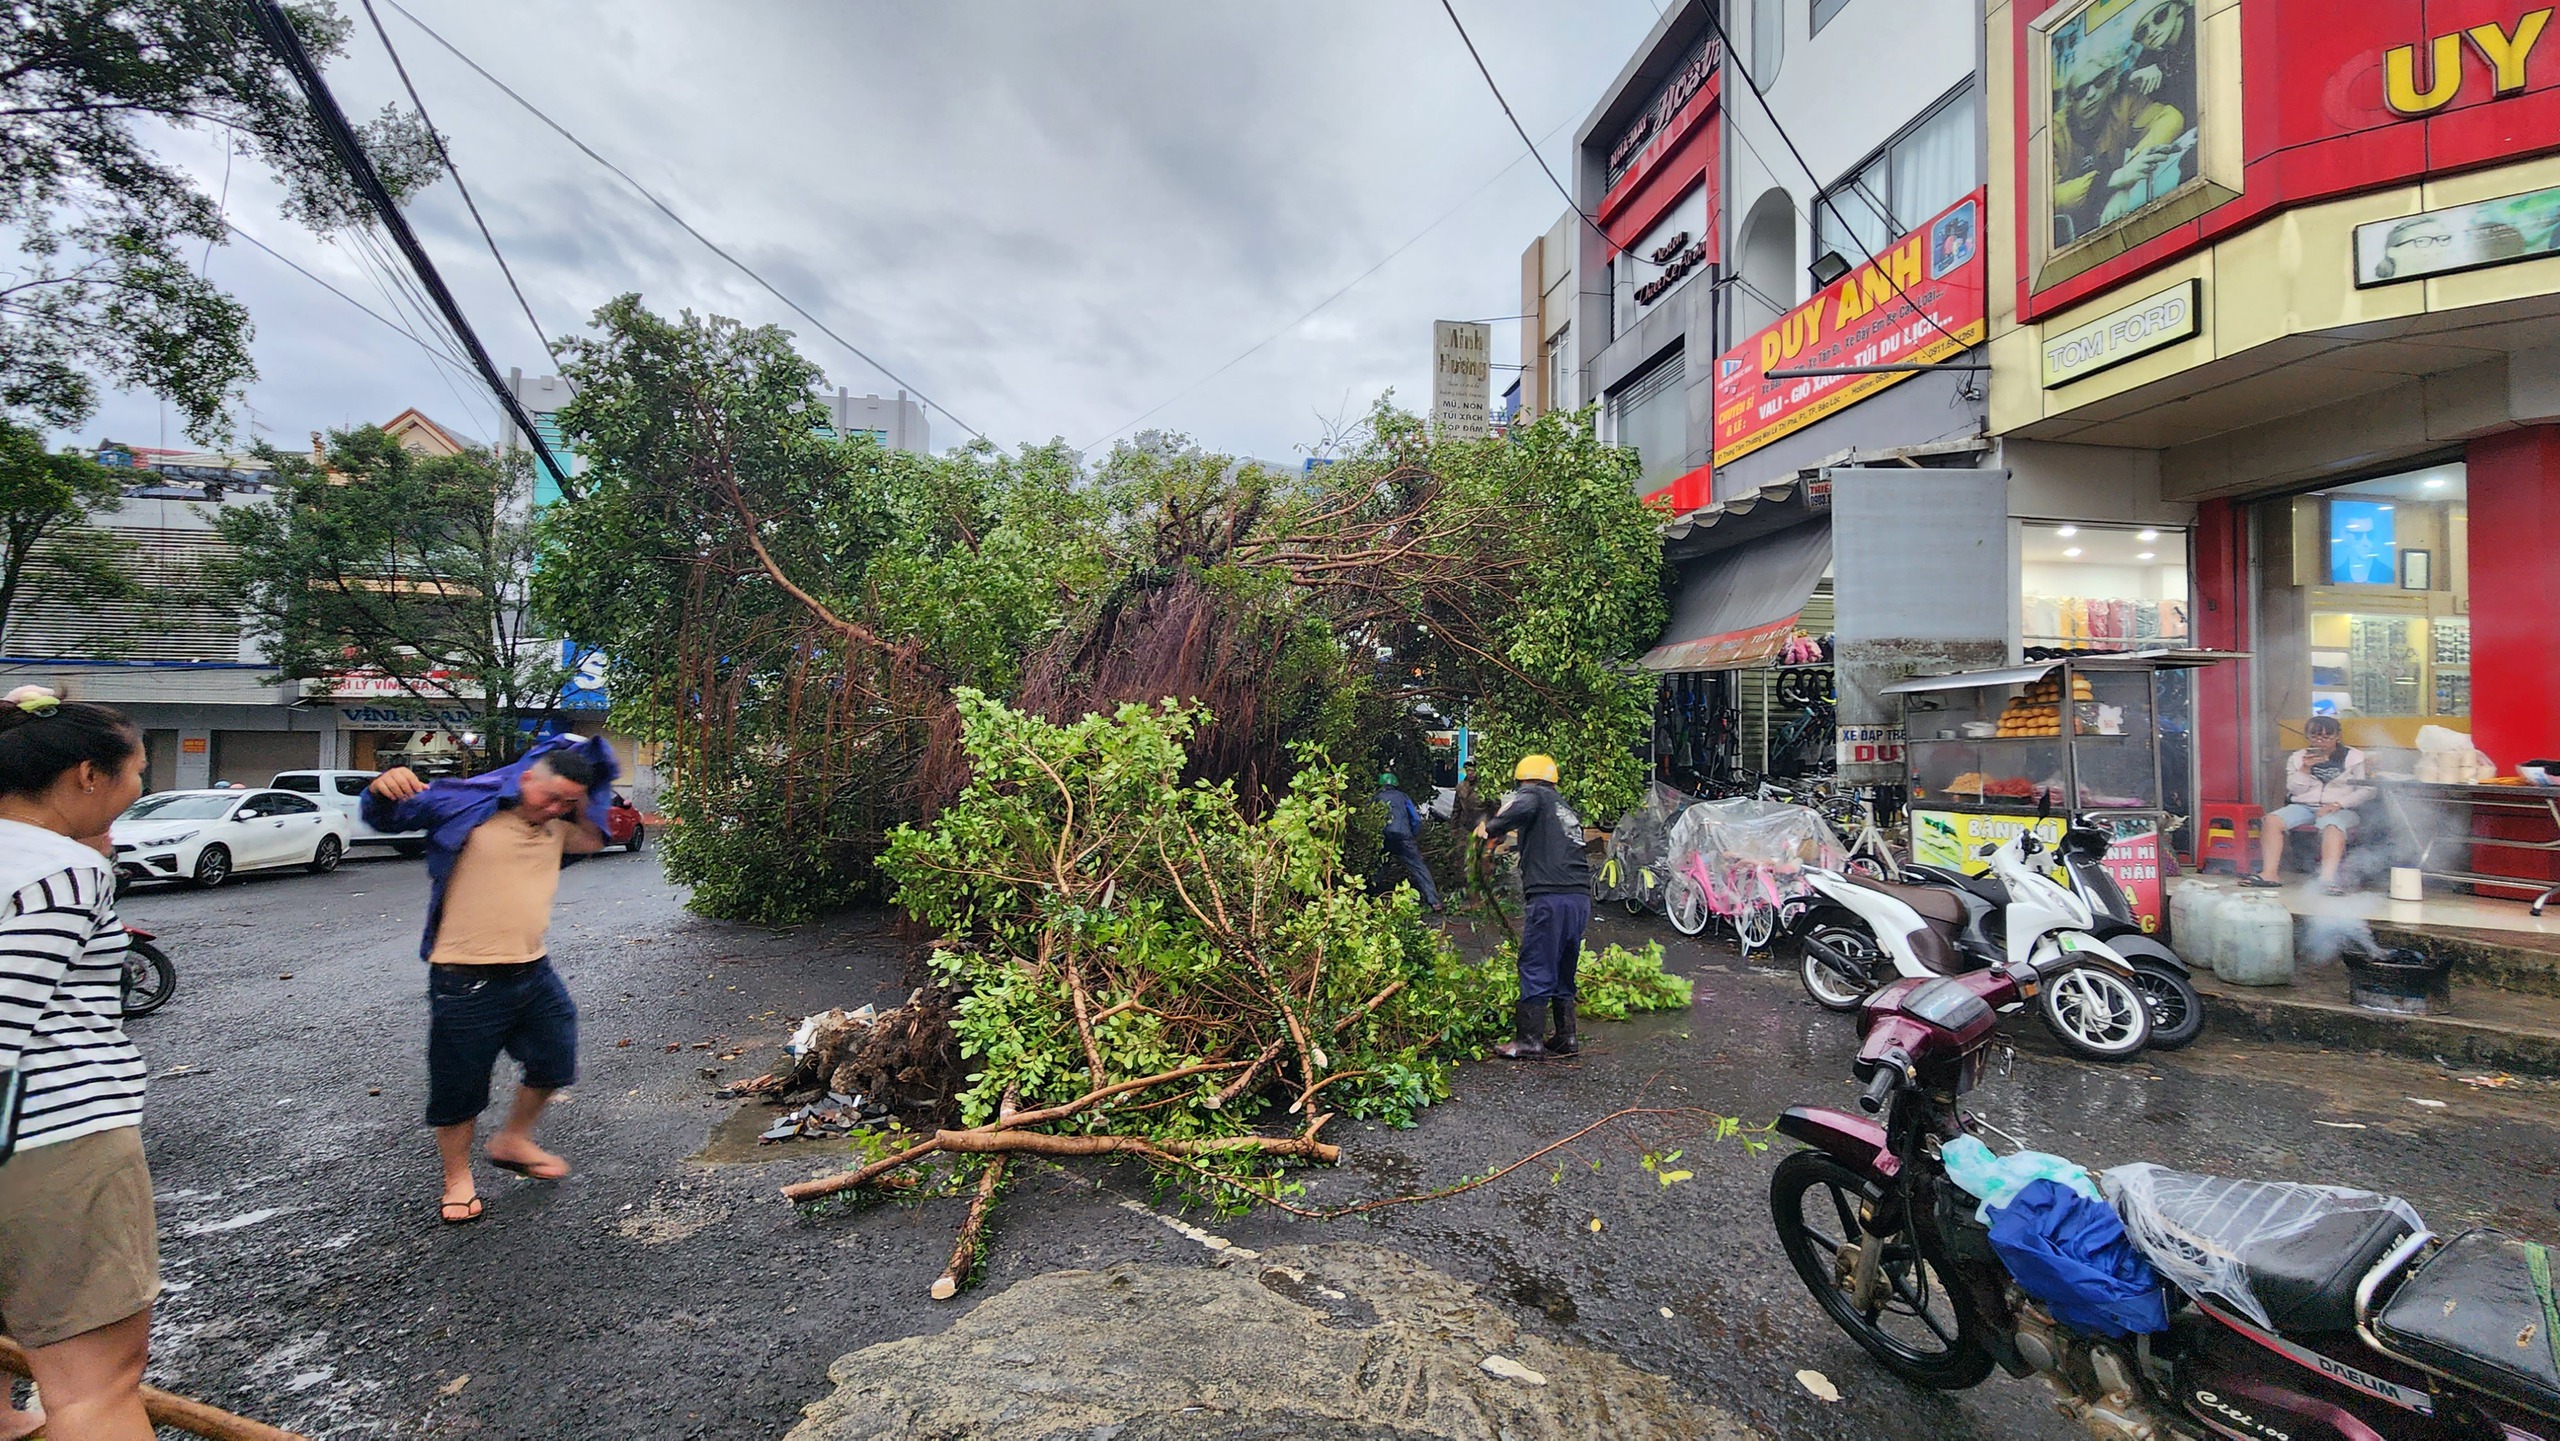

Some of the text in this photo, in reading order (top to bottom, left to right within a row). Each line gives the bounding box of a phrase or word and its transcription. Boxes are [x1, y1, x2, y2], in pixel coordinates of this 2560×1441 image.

[2383, 6, 2555, 118] UY
[1761, 235, 1923, 373] DUY ANH
[2047, 298, 2186, 373] TOM FORD
[1759, 395, 1783, 420] VALI
[1854, 343, 1878, 368] TÚI
[1880, 332, 1899, 358] DU
[1843, 730, 1857, 741] XE
[1855, 745, 1906, 762] DU
[2138, 842, 2155, 860] MÌ
[2318, 1357, 2400, 1400] DAELIM
